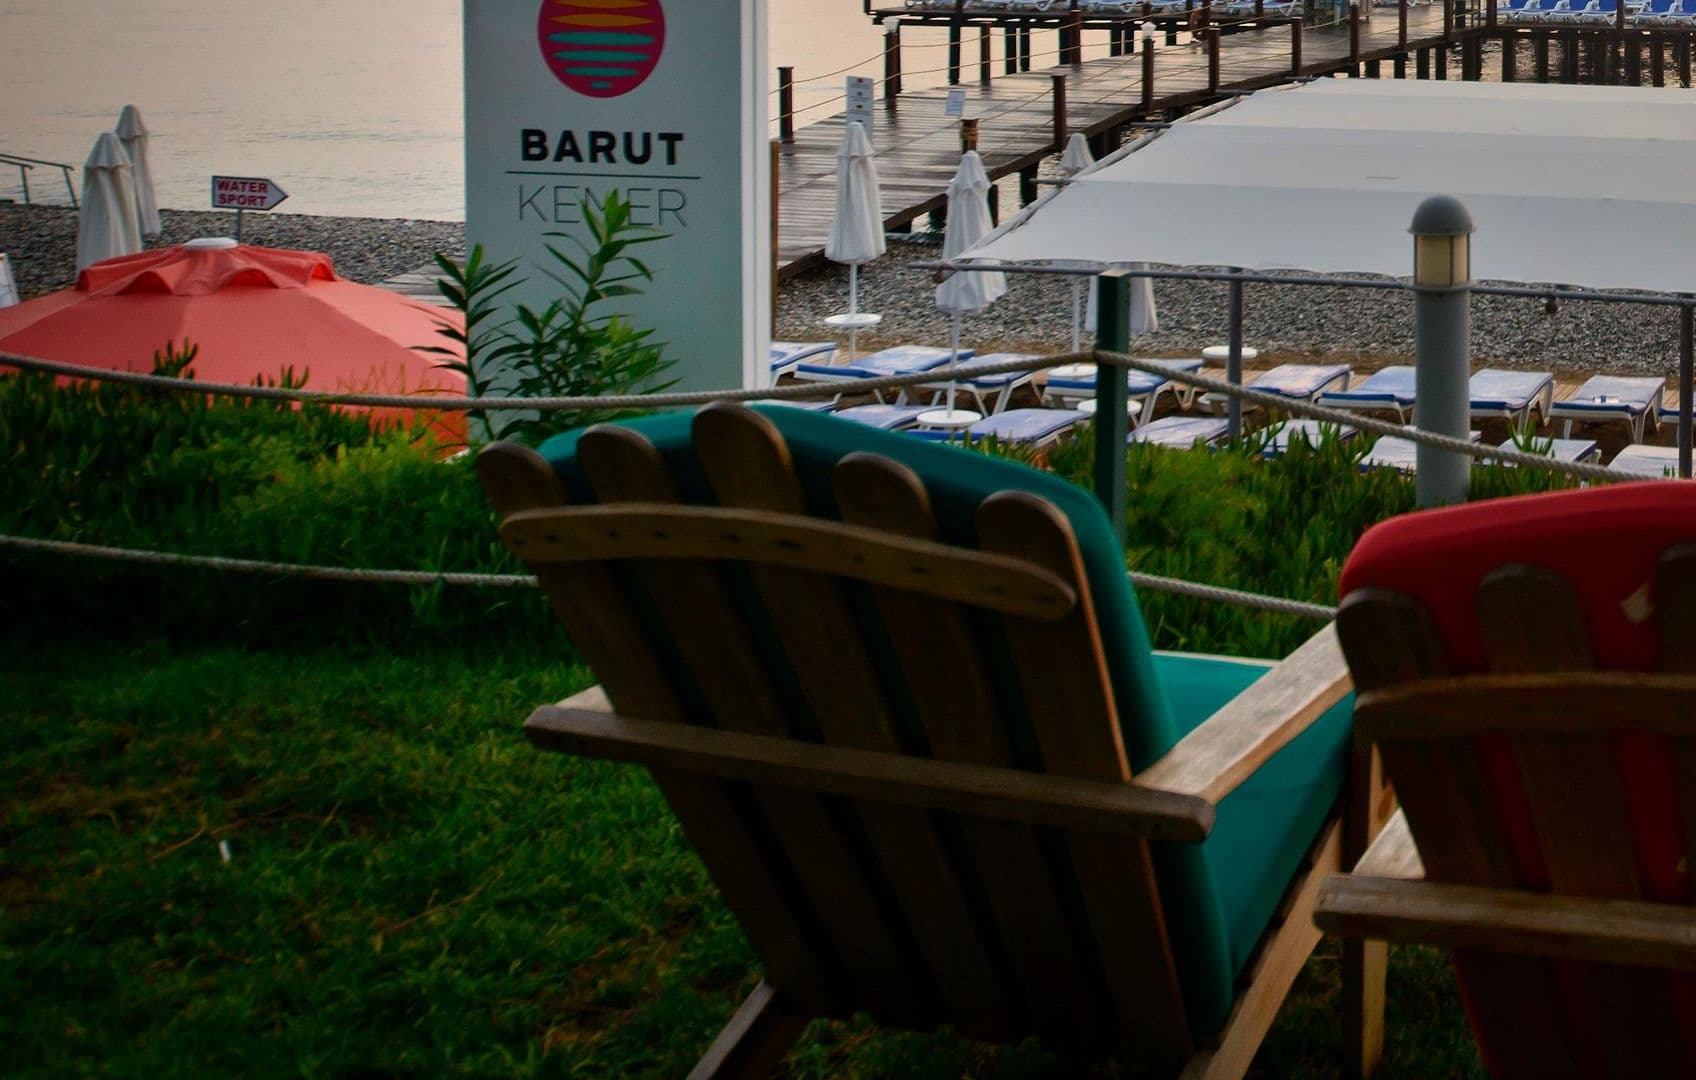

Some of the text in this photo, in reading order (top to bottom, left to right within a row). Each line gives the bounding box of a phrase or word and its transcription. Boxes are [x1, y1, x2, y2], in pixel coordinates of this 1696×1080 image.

[521, 128, 684, 165] BARUT
[216, 181, 268, 193] WATER
[218, 194, 267, 206] SPORT
